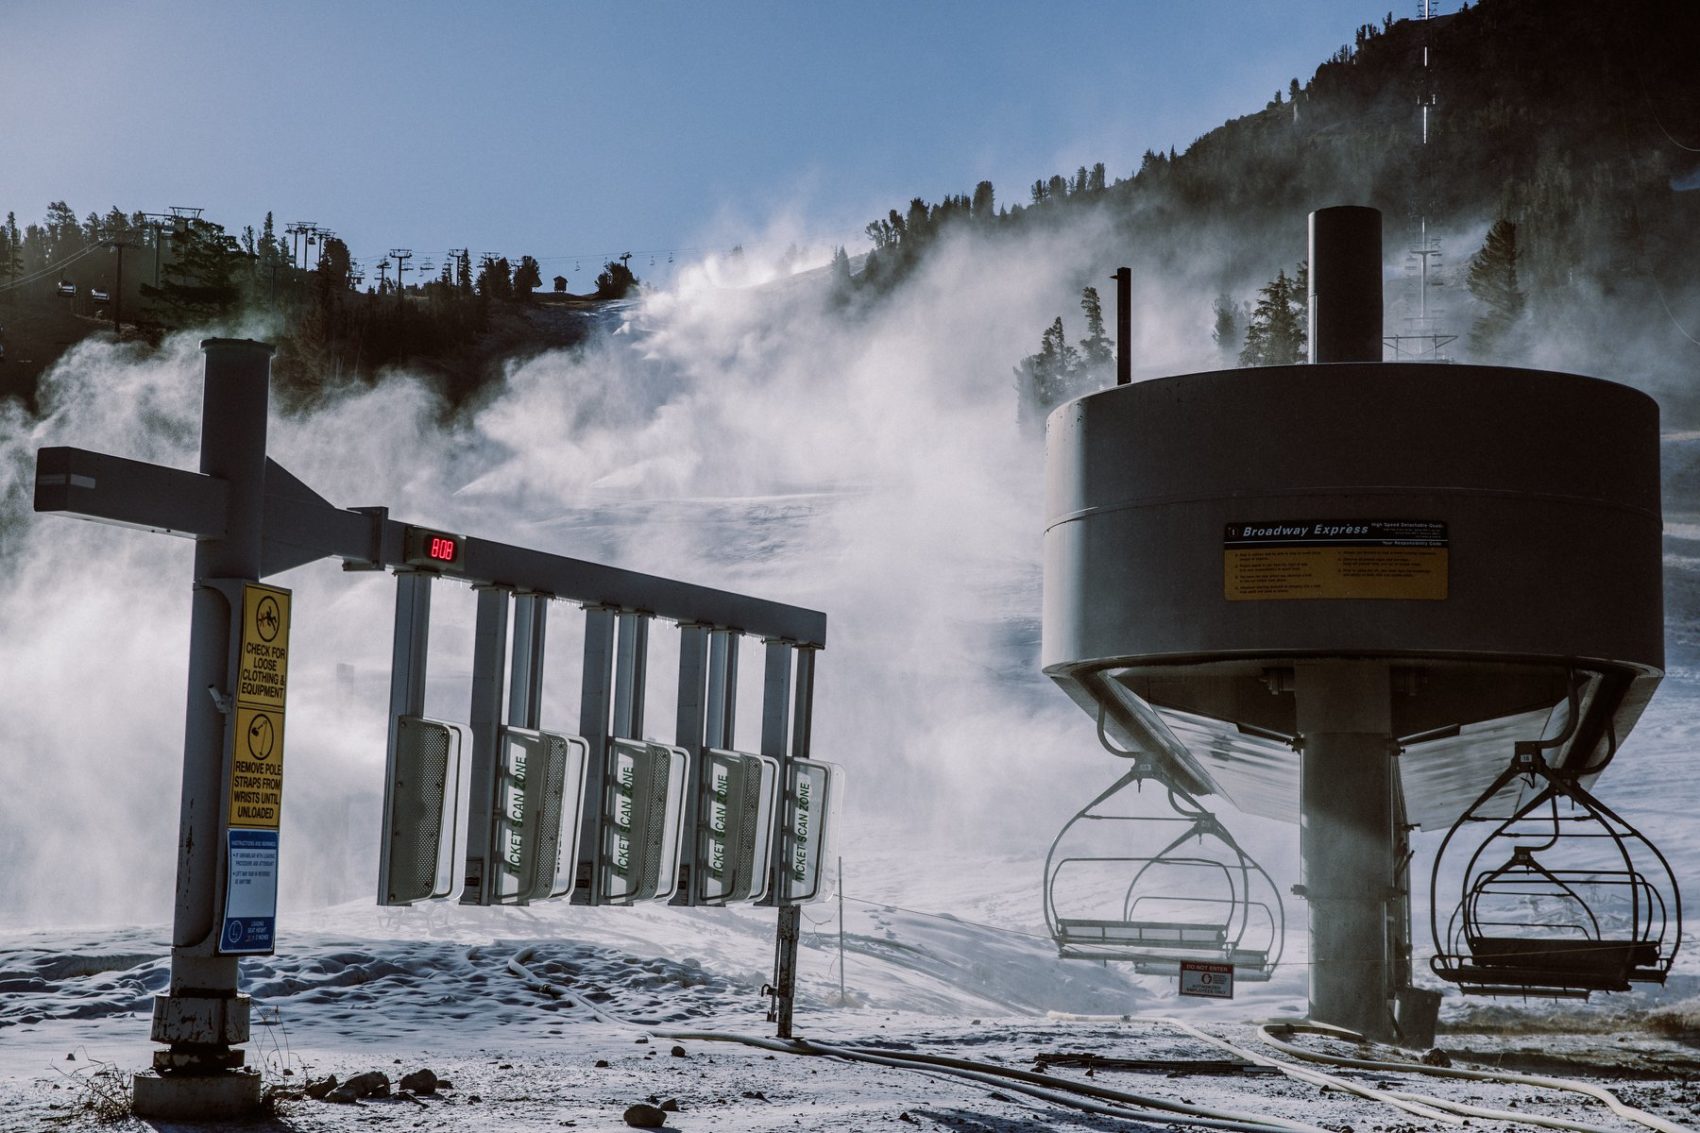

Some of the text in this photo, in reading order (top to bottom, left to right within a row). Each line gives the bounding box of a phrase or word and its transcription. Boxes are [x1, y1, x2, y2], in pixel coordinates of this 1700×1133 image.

[1243, 524, 1369, 537] Broadway Express
[432, 538, 454, 560] 808
[246, 642, 285, 660] CHECK FOR
[254, 658, 277, 671] LOOSE
[243, 669, 284, 685] CLOTHING &
[241, 682, 283, 698] EQUIPMENT
[236, 761, 282, 775] REMOVE POLE
[234, 776, 280, 790] STRAPS FROM
[234, 790, 278, 805] WRISTS UNTIL
[238, 806, 274, 819] UNLOADED
[509, 756, 527, 874] TICKET SCAN ZONE
[617, 767, 634, 876] TICKET SCAN ZONE
[713, 774, 728, 879] TICKET SCAN ZONE
[795, 782, 810, 882] TICKET SCAN ZONE
